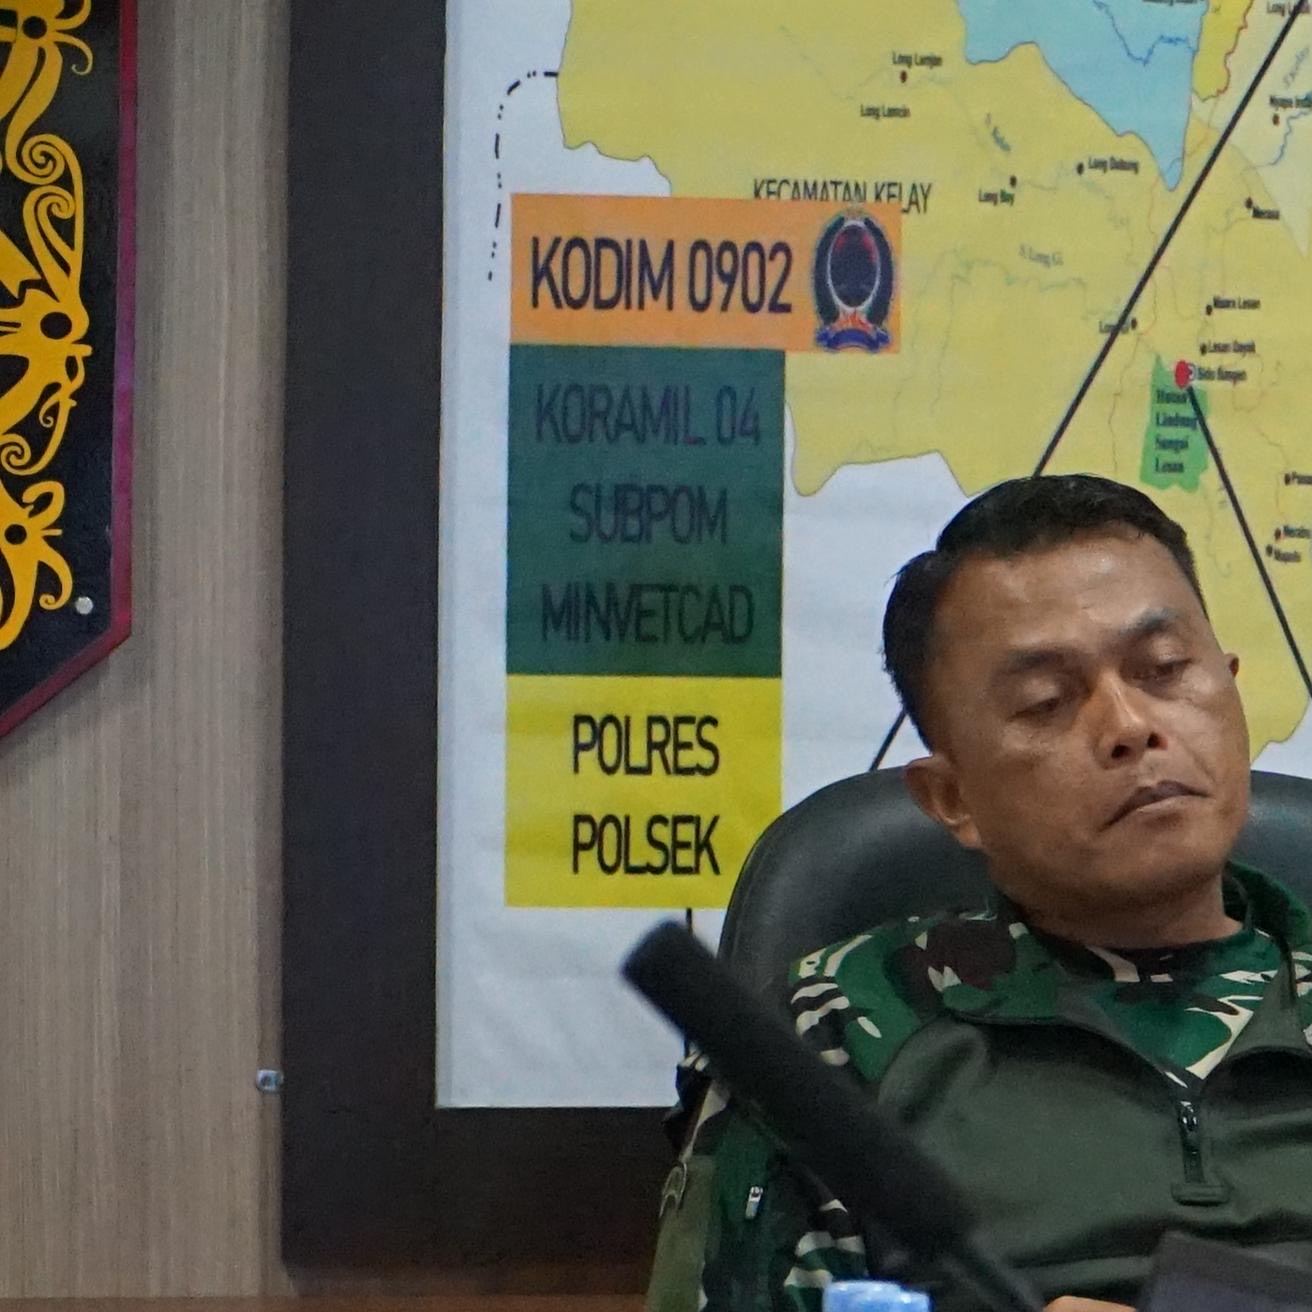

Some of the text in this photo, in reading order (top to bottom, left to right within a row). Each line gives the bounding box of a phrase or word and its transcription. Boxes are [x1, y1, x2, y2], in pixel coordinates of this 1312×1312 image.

[753, 179, 931, 213] KECAMATAN KELAY
[530, 236, 793, 314] KODIM 0902
[535, 384, 760, 446] KORAMIL 04
[569, 484, 727, 544] SUBPOM
[541, 584, 755, 646] MINVETCAD
[573, 714, 720, 776] POLRES
[573, 814, 721, 876] POLSEK
